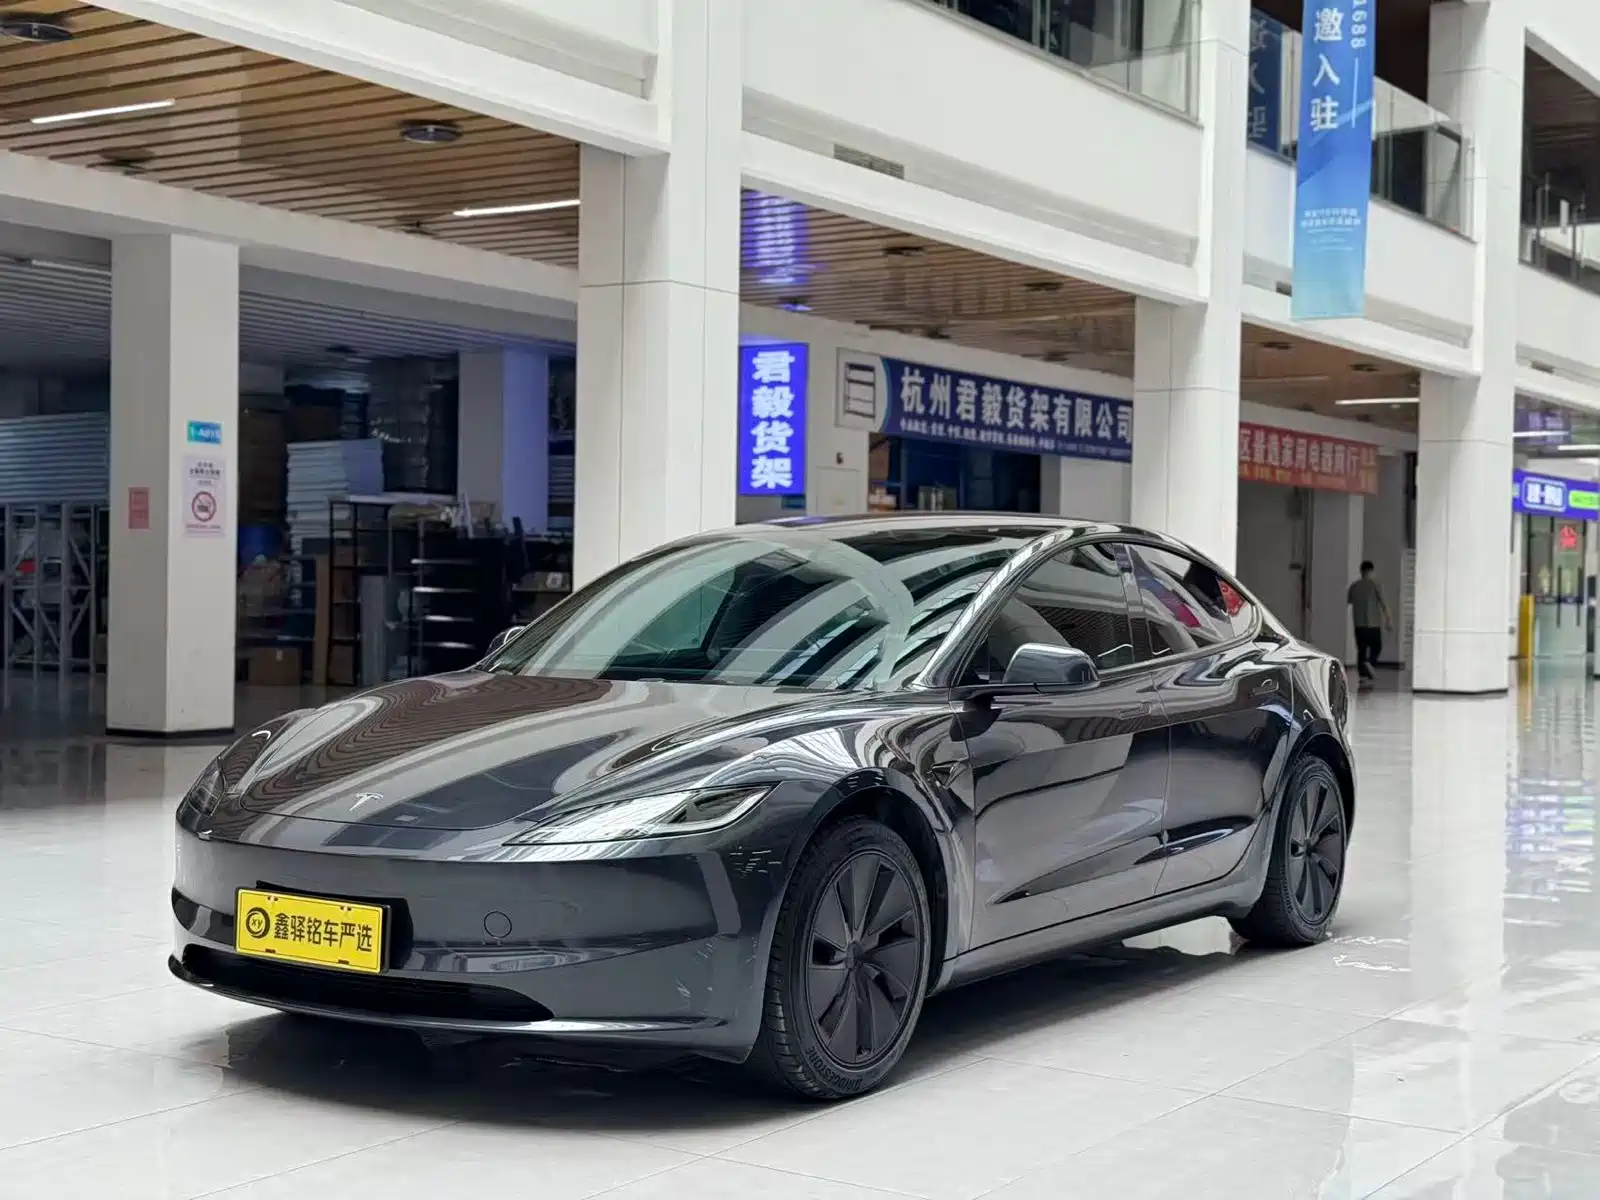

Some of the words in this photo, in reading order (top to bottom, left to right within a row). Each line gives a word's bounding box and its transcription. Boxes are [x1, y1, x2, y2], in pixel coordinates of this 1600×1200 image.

[1310, 7, 1344, 132] 邀入驻
[750, 350, 796, 489] 君毅货架
[900, 366, 1133, 444] 杭州君毅货架有限公司
[274, 912, 373, 952] 鑫驿铭车严选
